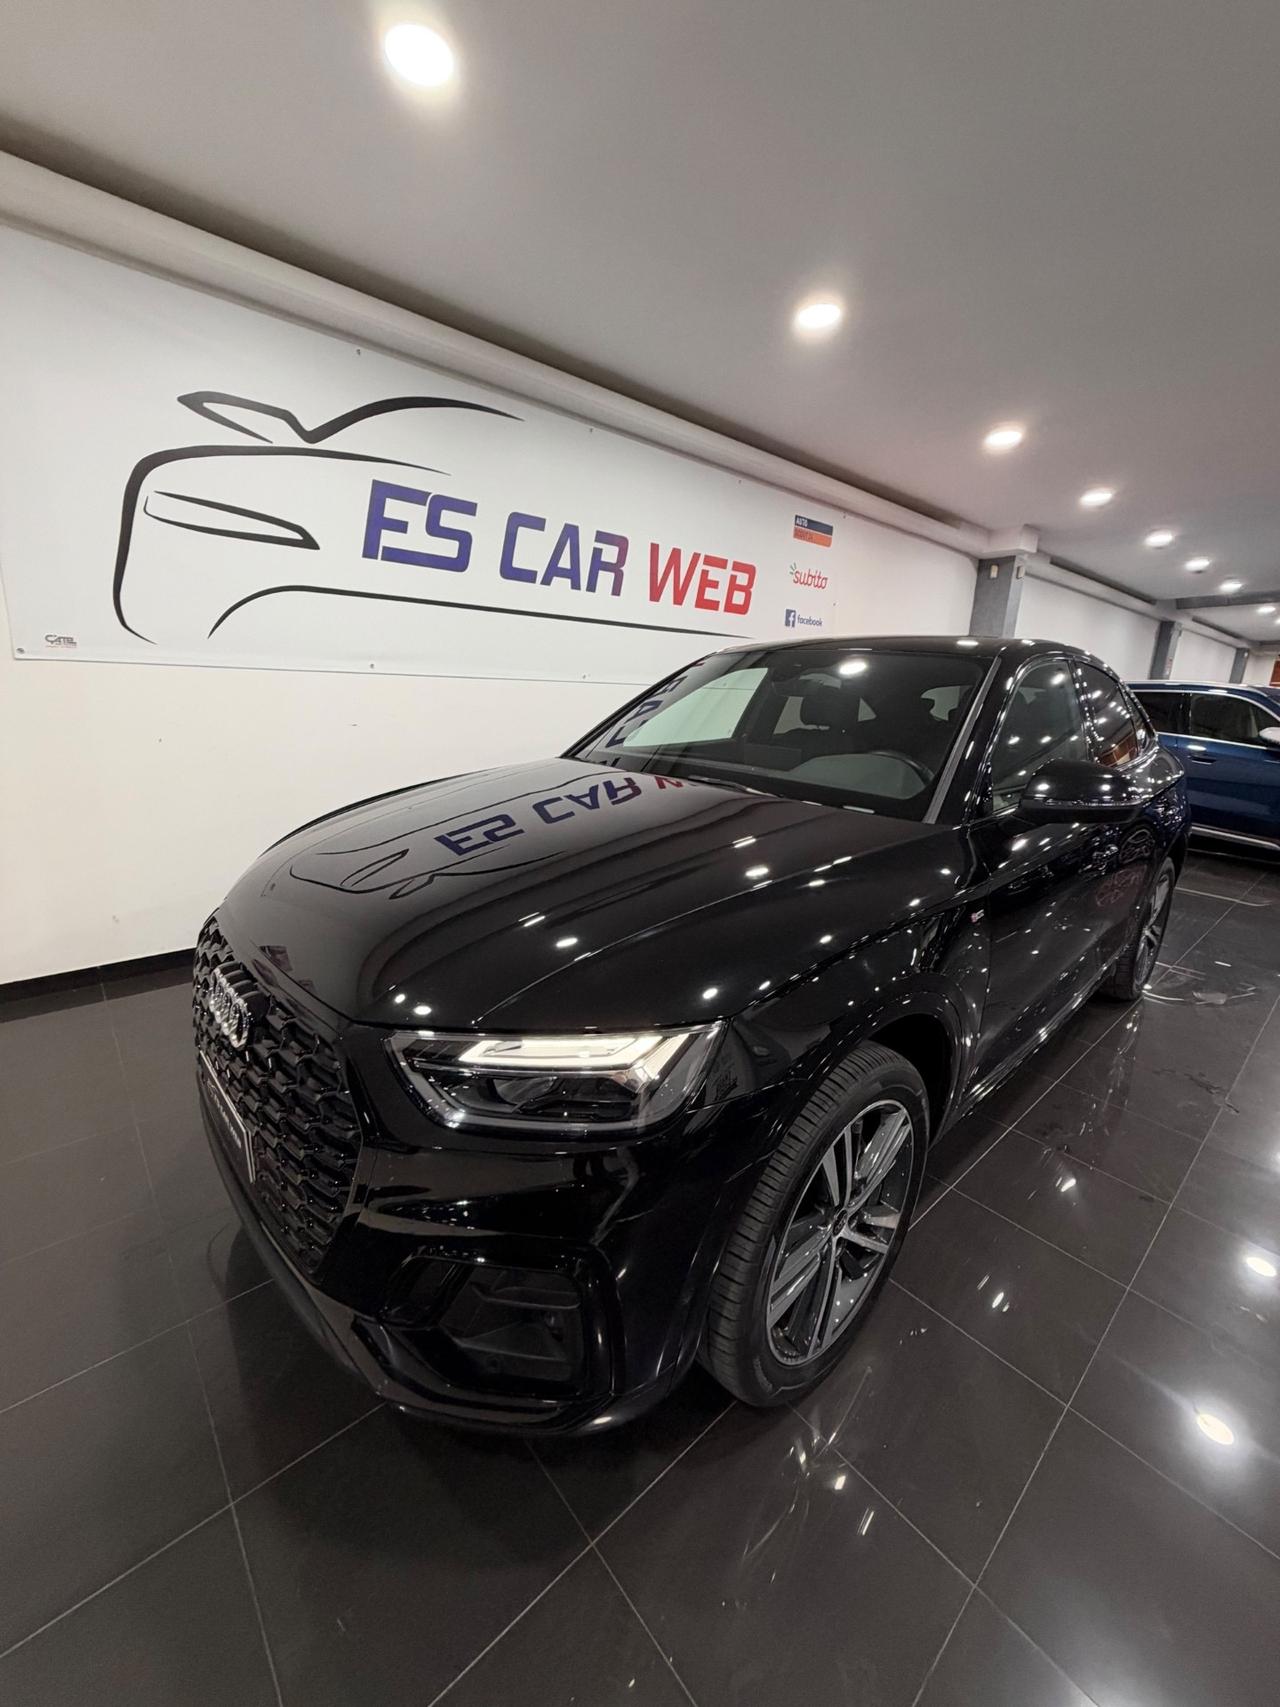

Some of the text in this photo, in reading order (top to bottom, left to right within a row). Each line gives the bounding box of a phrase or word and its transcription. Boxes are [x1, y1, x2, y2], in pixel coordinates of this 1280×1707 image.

[361, 479, 757, 616] ES CAR WEB
[793, 568, 828, 590] subito
[797, 614, 823, 627] facebook
